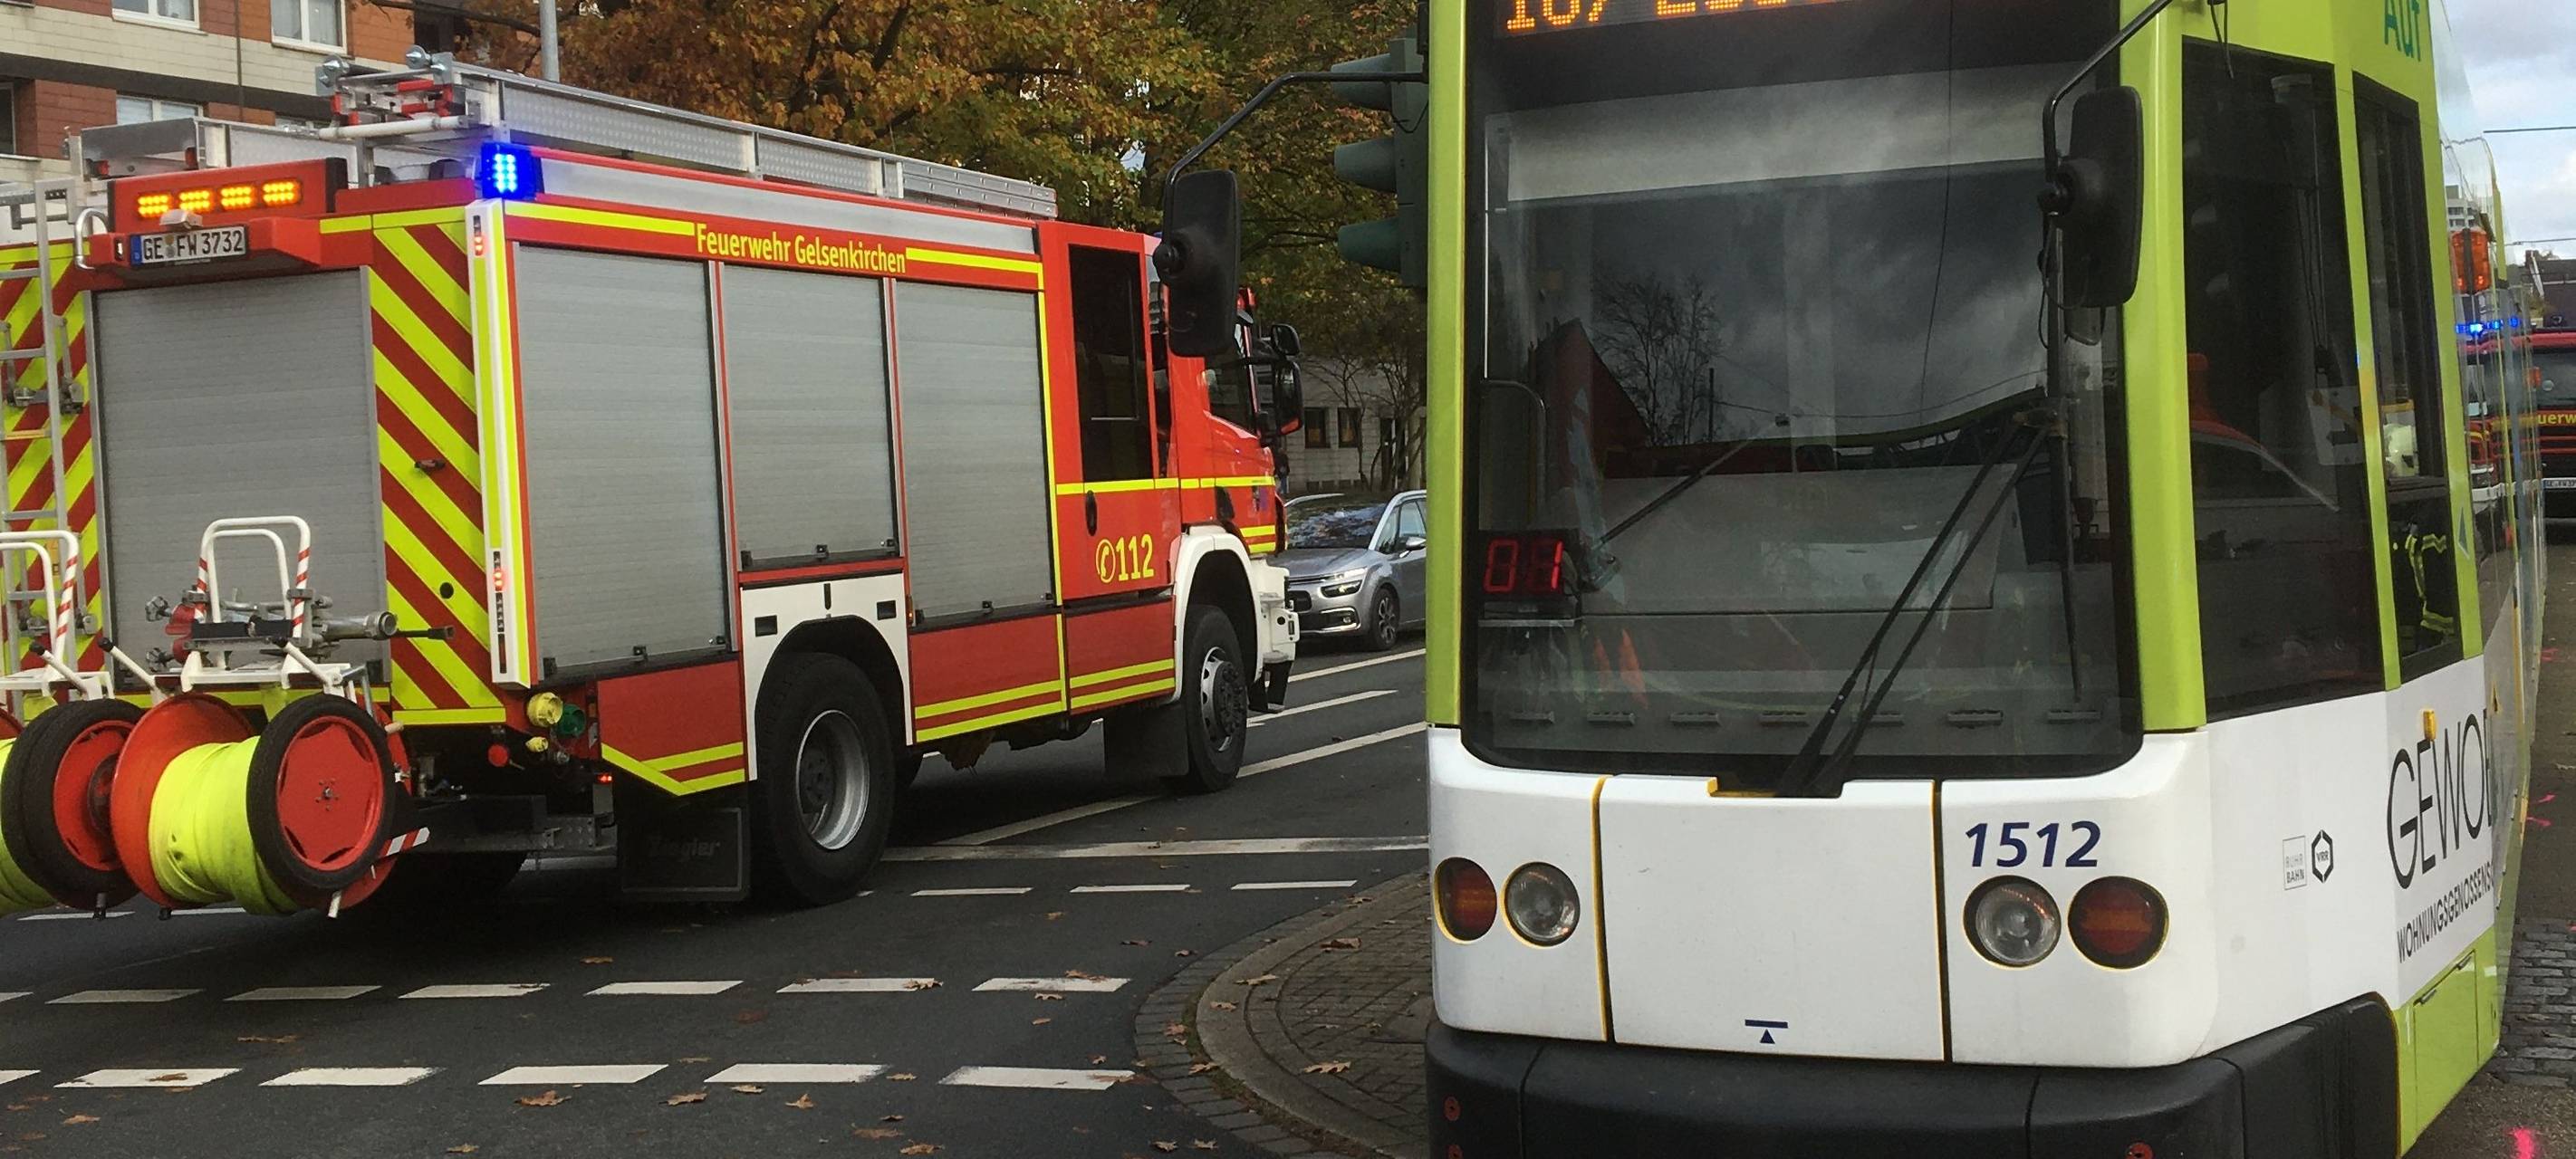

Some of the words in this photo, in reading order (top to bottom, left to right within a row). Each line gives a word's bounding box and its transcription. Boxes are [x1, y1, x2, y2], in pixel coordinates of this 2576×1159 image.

[143, 237, 163, 260] GE
[177, 235, 197, 256] FW
[201, 230, 244, 254] 3732
[697, 223, 791, 263] Feuerwehr
[794, 235, 906, 273] Gelsenkirchen
[1116, 534, 1154, 581] 112
[1483, 538, 1564, 593] 01
[1965, 820, 2101, 867] 1512
[2316, 850, 2330, 863] VRR
[2286, 869, 2305, 884] BAHN
